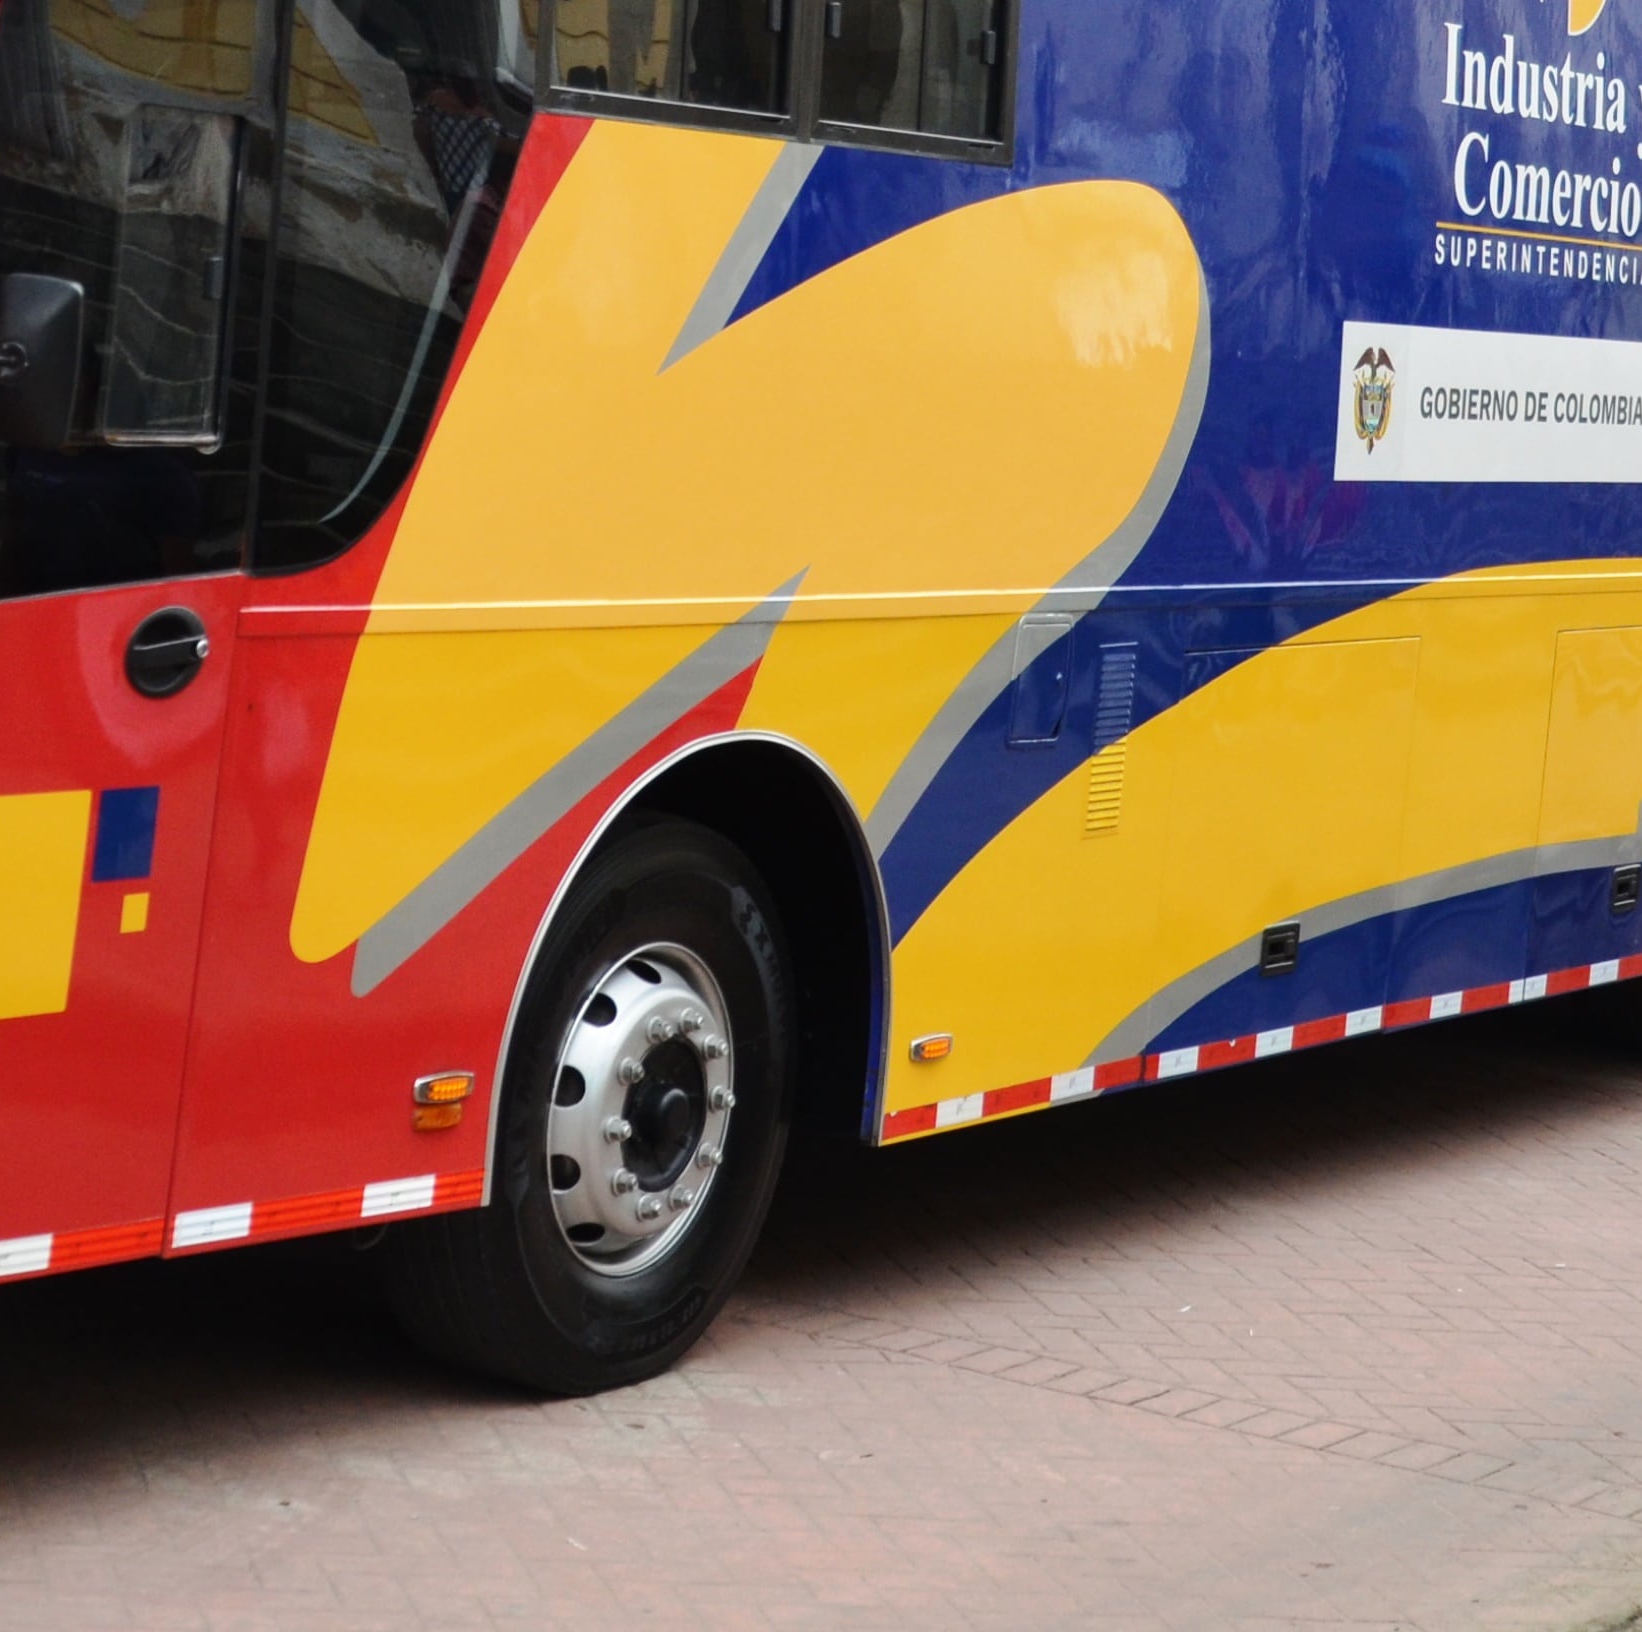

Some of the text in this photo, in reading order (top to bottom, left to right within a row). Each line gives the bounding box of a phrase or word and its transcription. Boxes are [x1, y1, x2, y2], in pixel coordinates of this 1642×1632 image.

[1442, 22, 1626, 134] Industria
[1455, 131, 1641, 238] Comercio
[1420, 385, 1519, 423] GOBIERNO
[1523, 390, 1548, 423] DE
